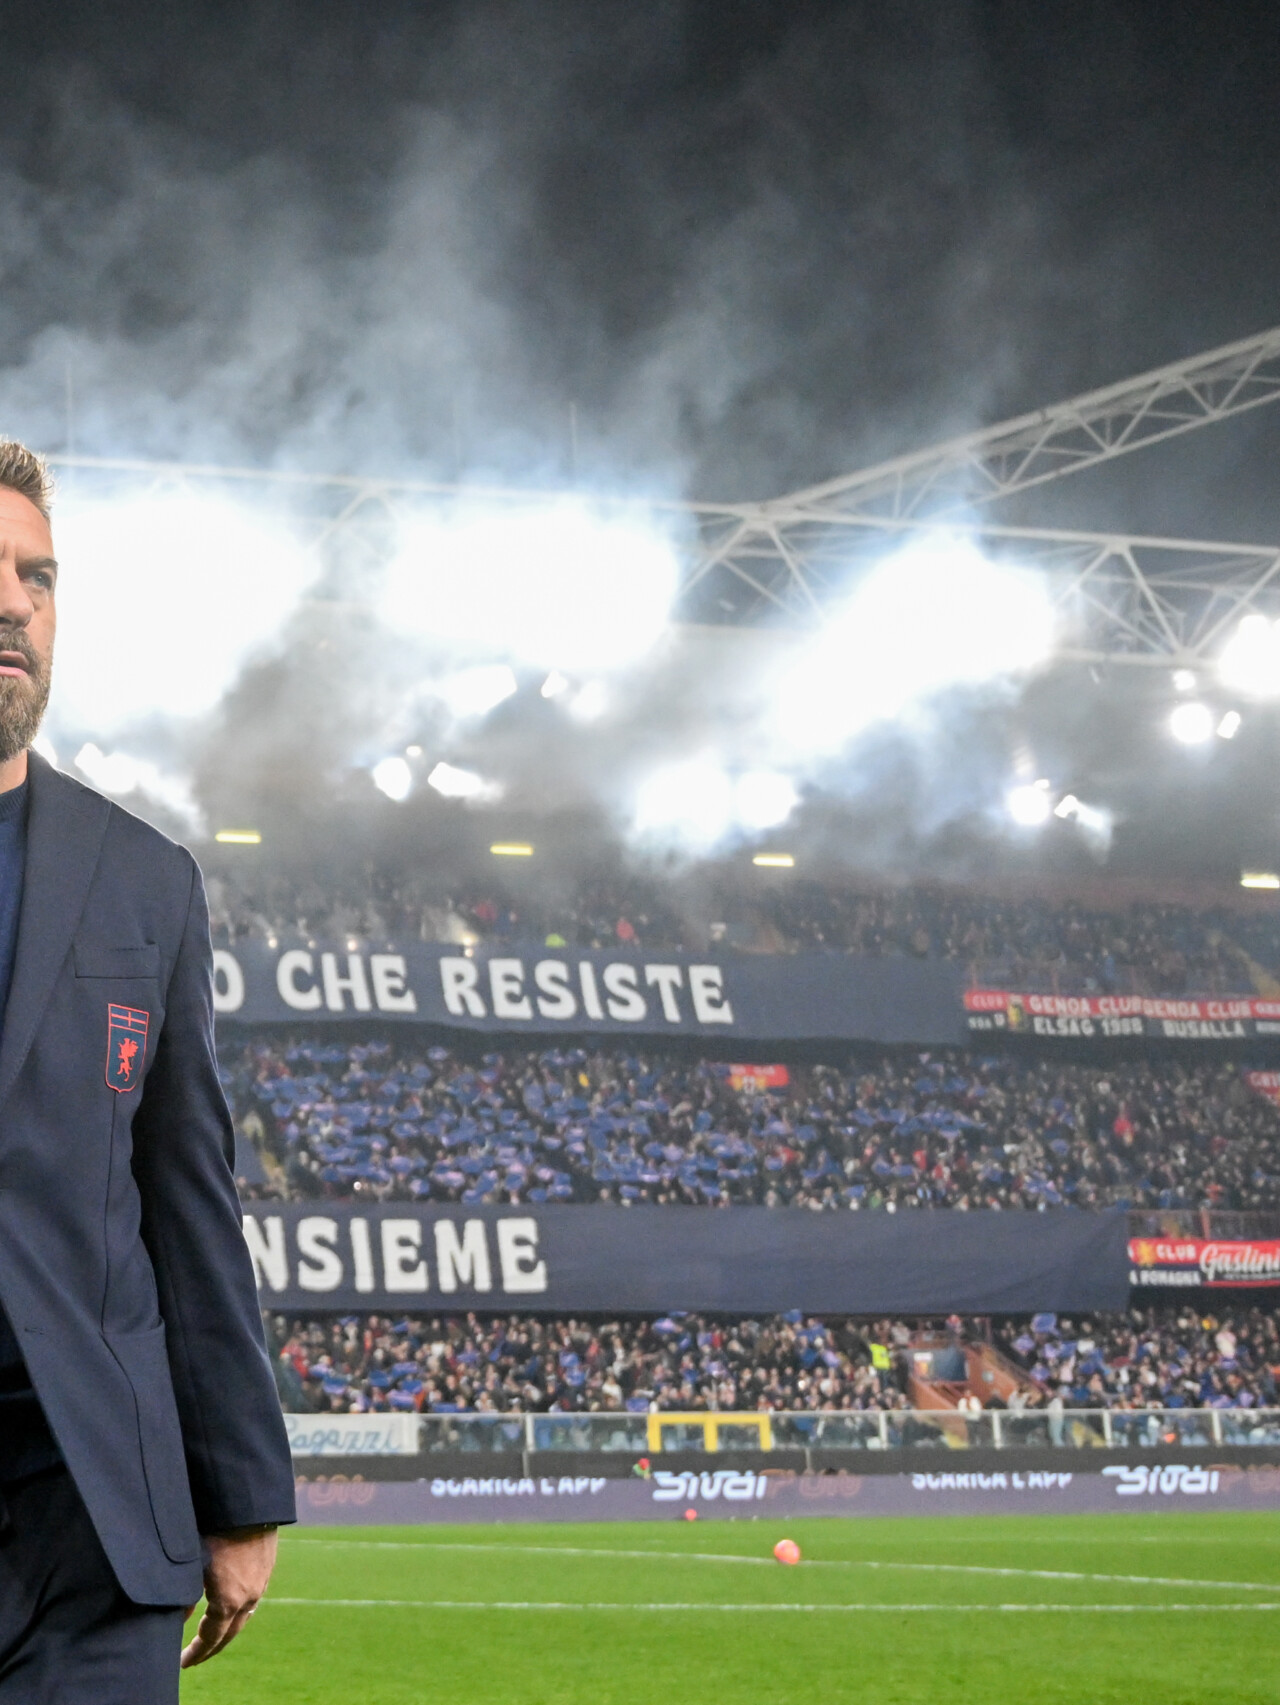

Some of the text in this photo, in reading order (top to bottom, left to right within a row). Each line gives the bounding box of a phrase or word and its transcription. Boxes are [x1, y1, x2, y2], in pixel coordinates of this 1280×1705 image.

[277, 949, 418, 1012] CHE
[440, 956, 735, 1025] RESISTE
[1029, 995, 1142, 1016] GENOA CLUB
